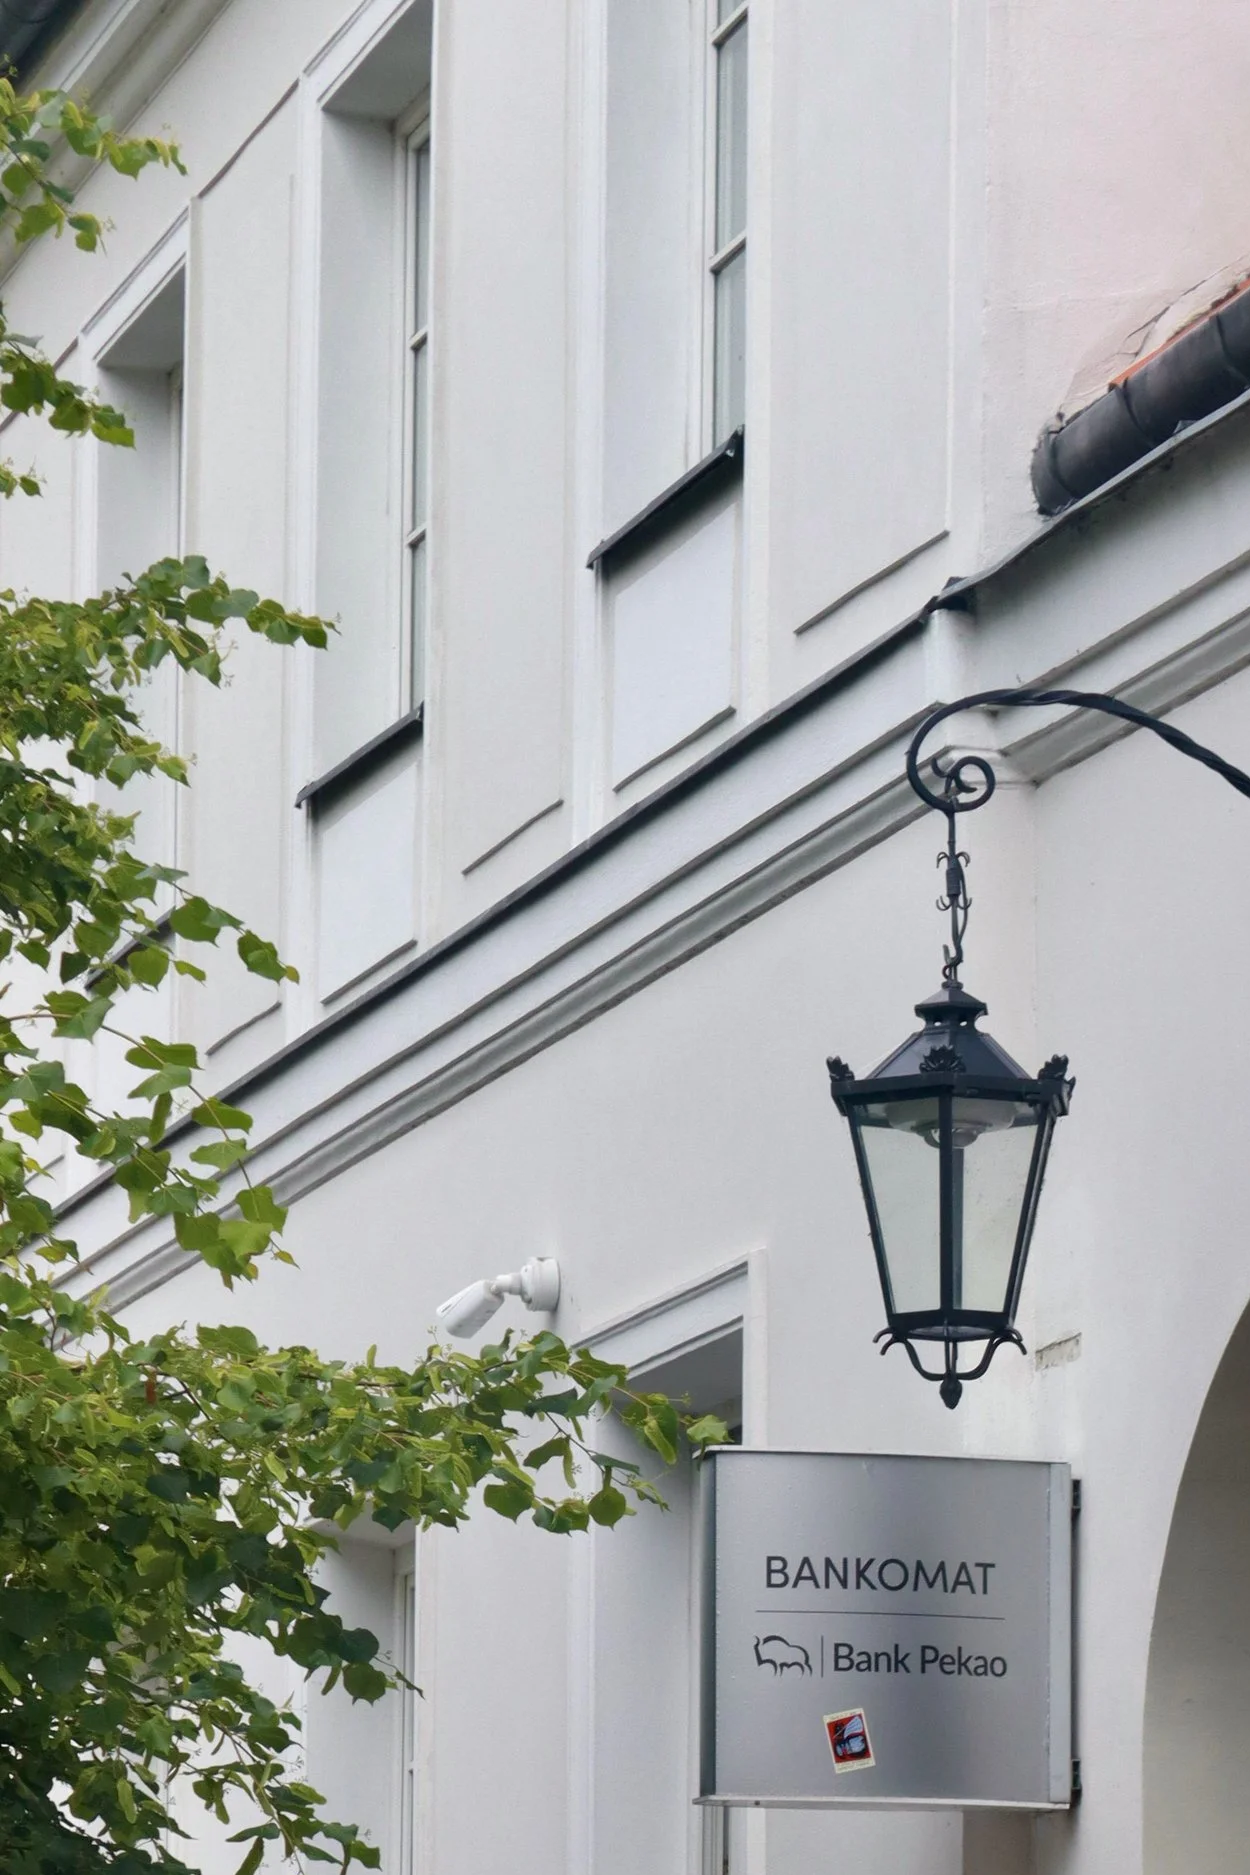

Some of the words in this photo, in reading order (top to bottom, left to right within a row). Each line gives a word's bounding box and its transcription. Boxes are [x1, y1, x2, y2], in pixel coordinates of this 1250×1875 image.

[765, 1555, 996, 1596] BANKOMAT
[833, 1641, 911, 1675] Bank
[920, 1644, 1008, 1678] Pekao
